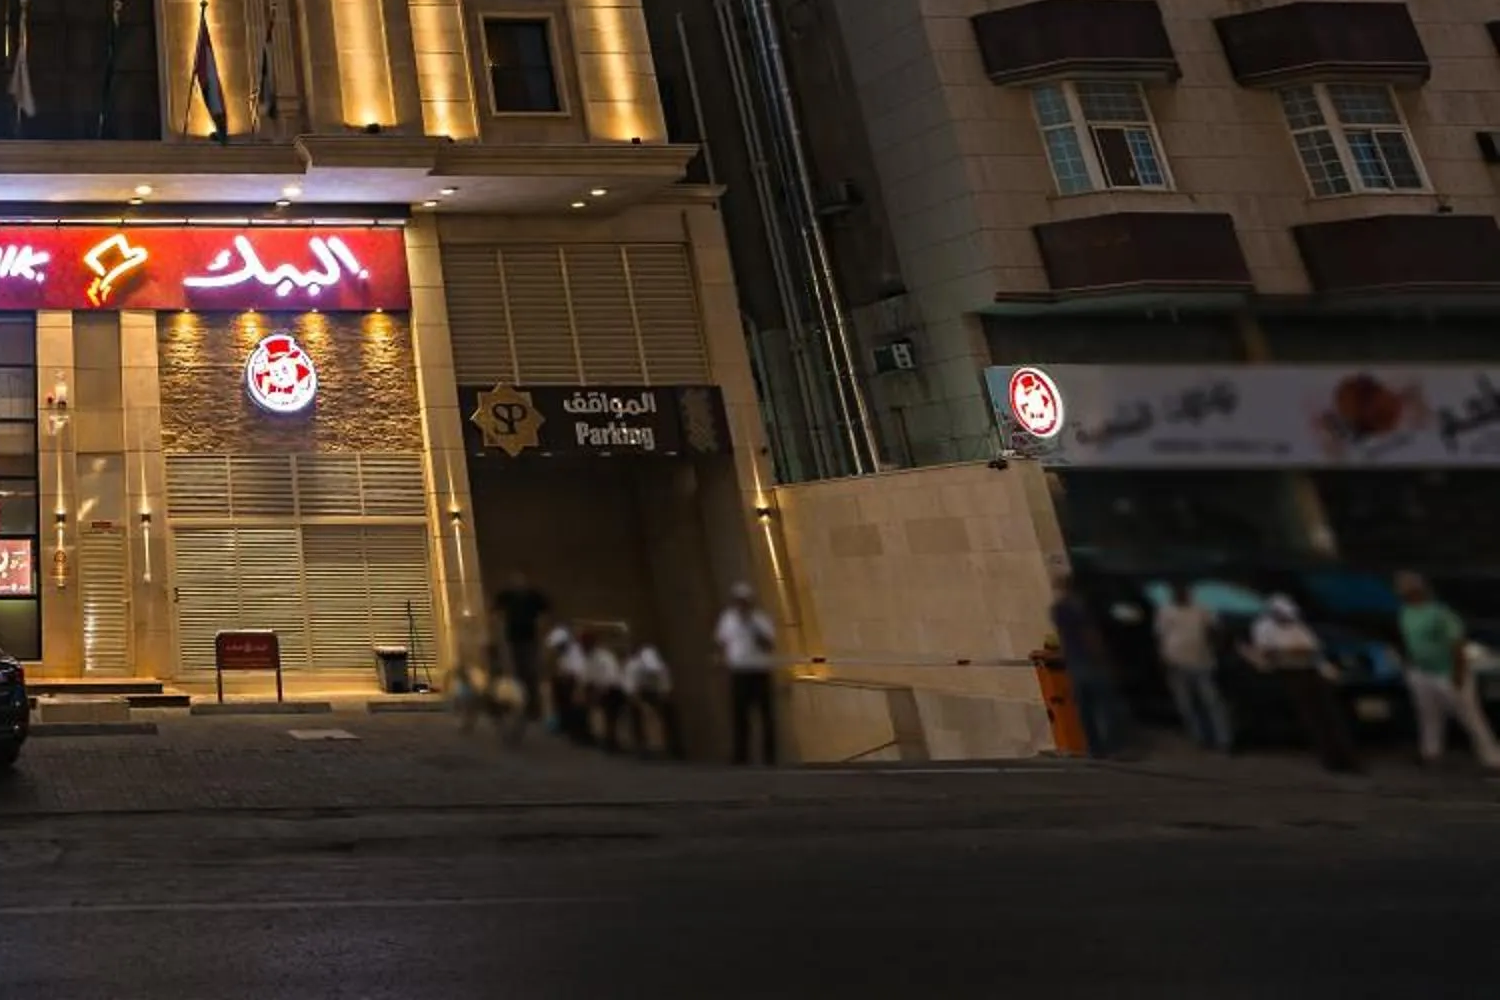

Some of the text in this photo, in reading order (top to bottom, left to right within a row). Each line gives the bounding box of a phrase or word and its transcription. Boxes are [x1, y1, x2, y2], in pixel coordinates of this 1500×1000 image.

[183, 235, 368, 297] البيك
[563, 391, 657, 418] المواقف
[575, 421, 656, 450] Parking
